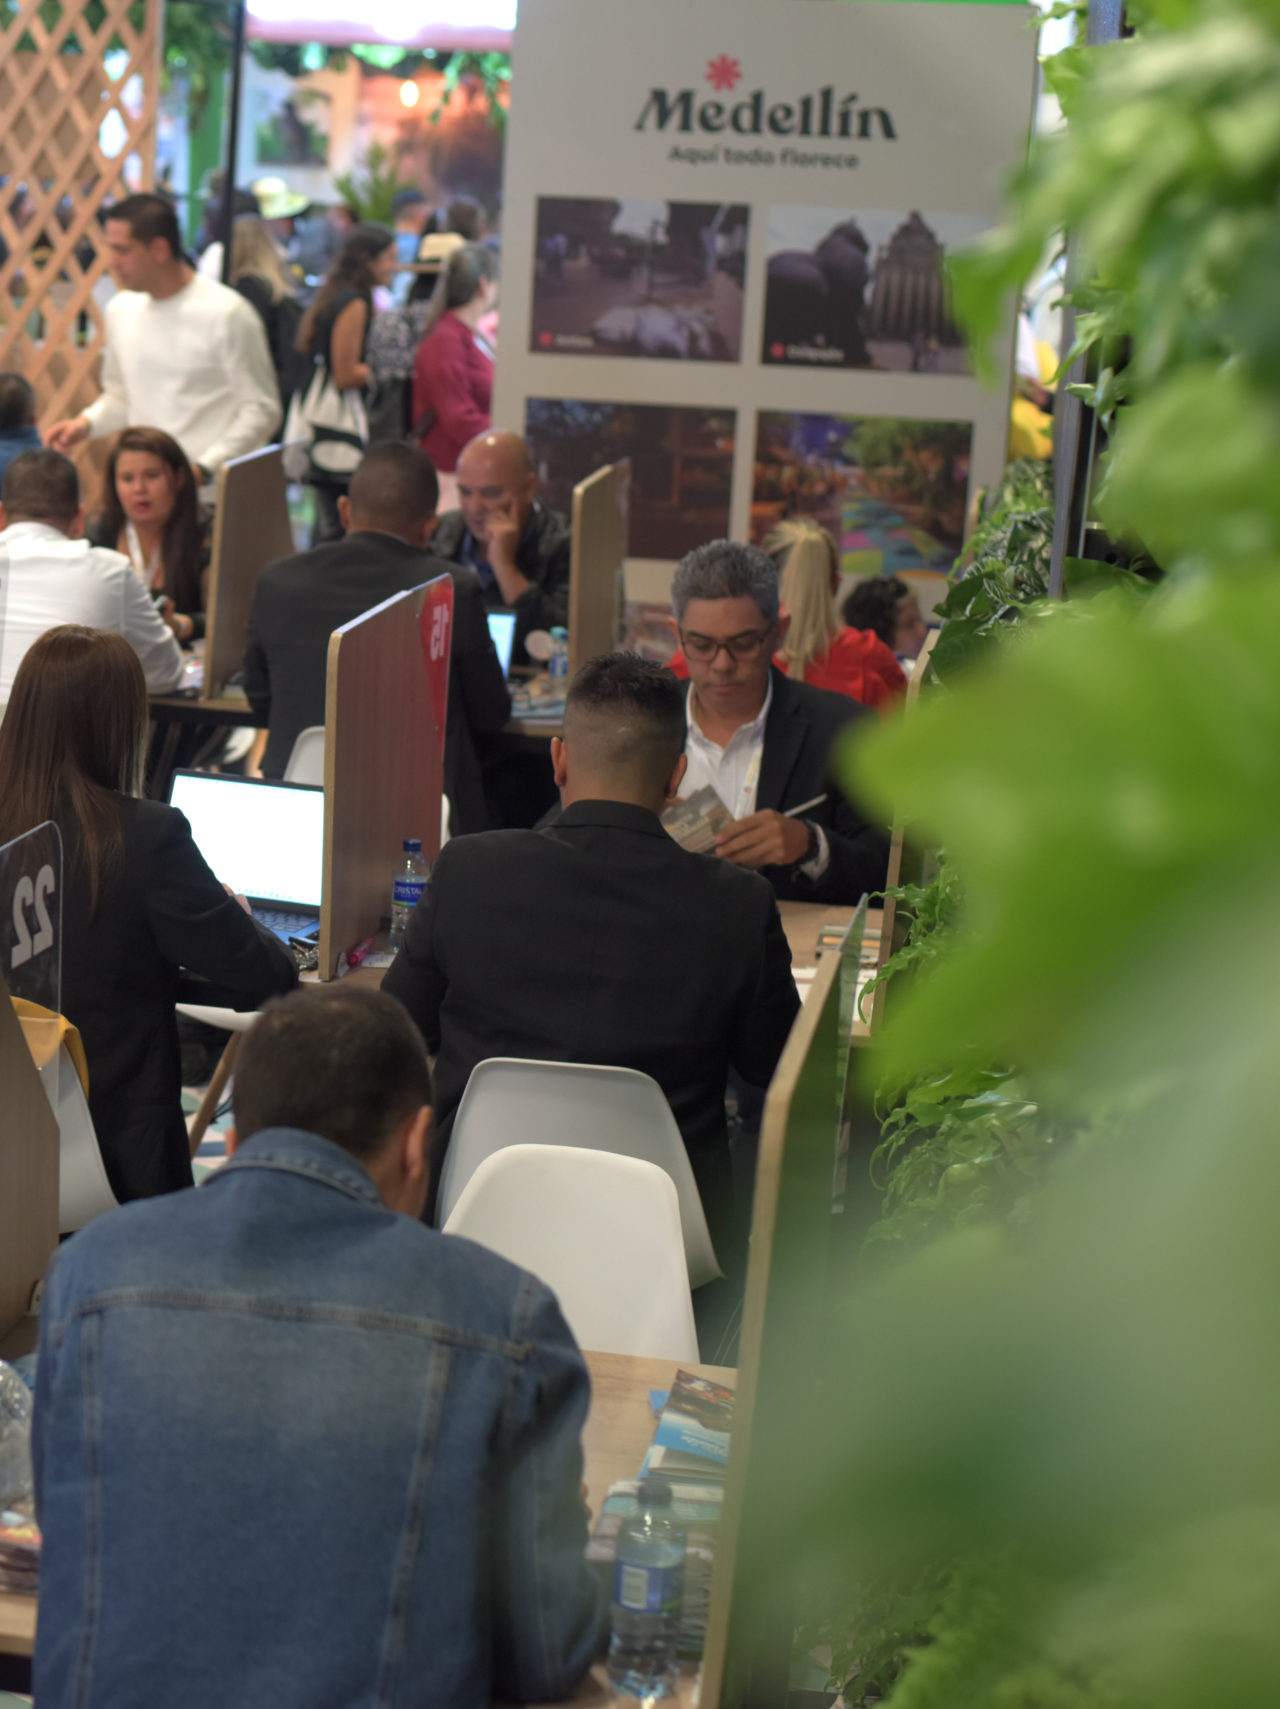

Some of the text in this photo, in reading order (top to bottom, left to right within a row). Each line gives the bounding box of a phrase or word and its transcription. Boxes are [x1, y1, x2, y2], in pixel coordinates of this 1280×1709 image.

[634, 84, 898, 141] Medellín
[668, 144, 860, 169] Aquí todo florece
